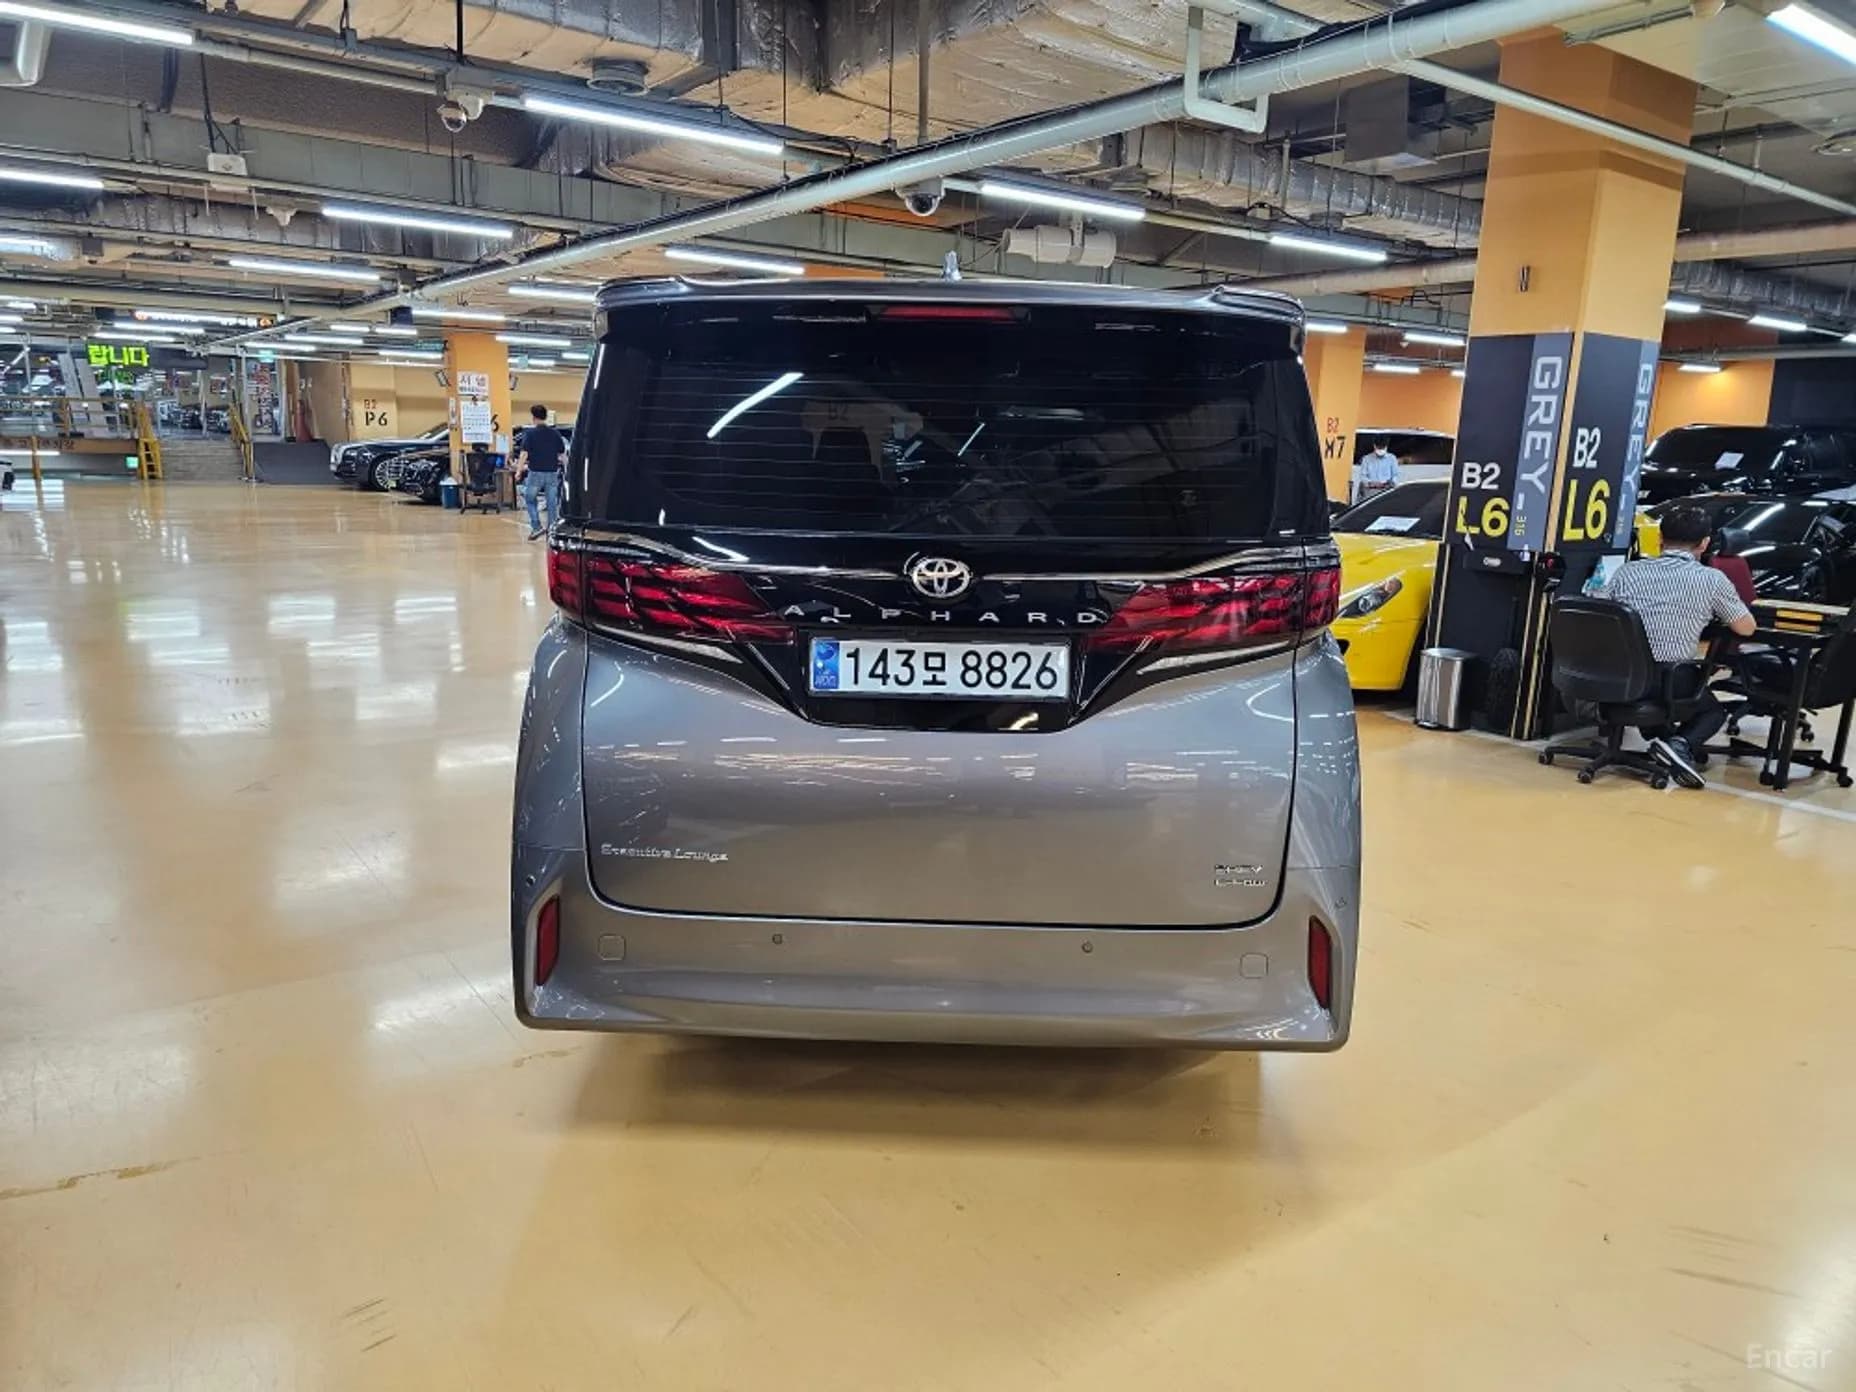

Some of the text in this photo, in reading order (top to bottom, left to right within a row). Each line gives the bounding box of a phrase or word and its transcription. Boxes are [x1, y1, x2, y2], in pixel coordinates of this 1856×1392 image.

[365, 411, 388, 426] P6
[1327, 417, 1340, 433] B2
[1519, 356, 1563, 494] GREY
[1623, 362, 1653, 492] GREY
[1572, 427, 1601, 468] B2
[1461, 462, 1501, 490] B2
[1455, 495, 1510, 537] L6
[1563, 478, 1611, 541] L6
[784, 603, 1099, 626] ALPHARD
[960, 650, 1058, 690] 8826
